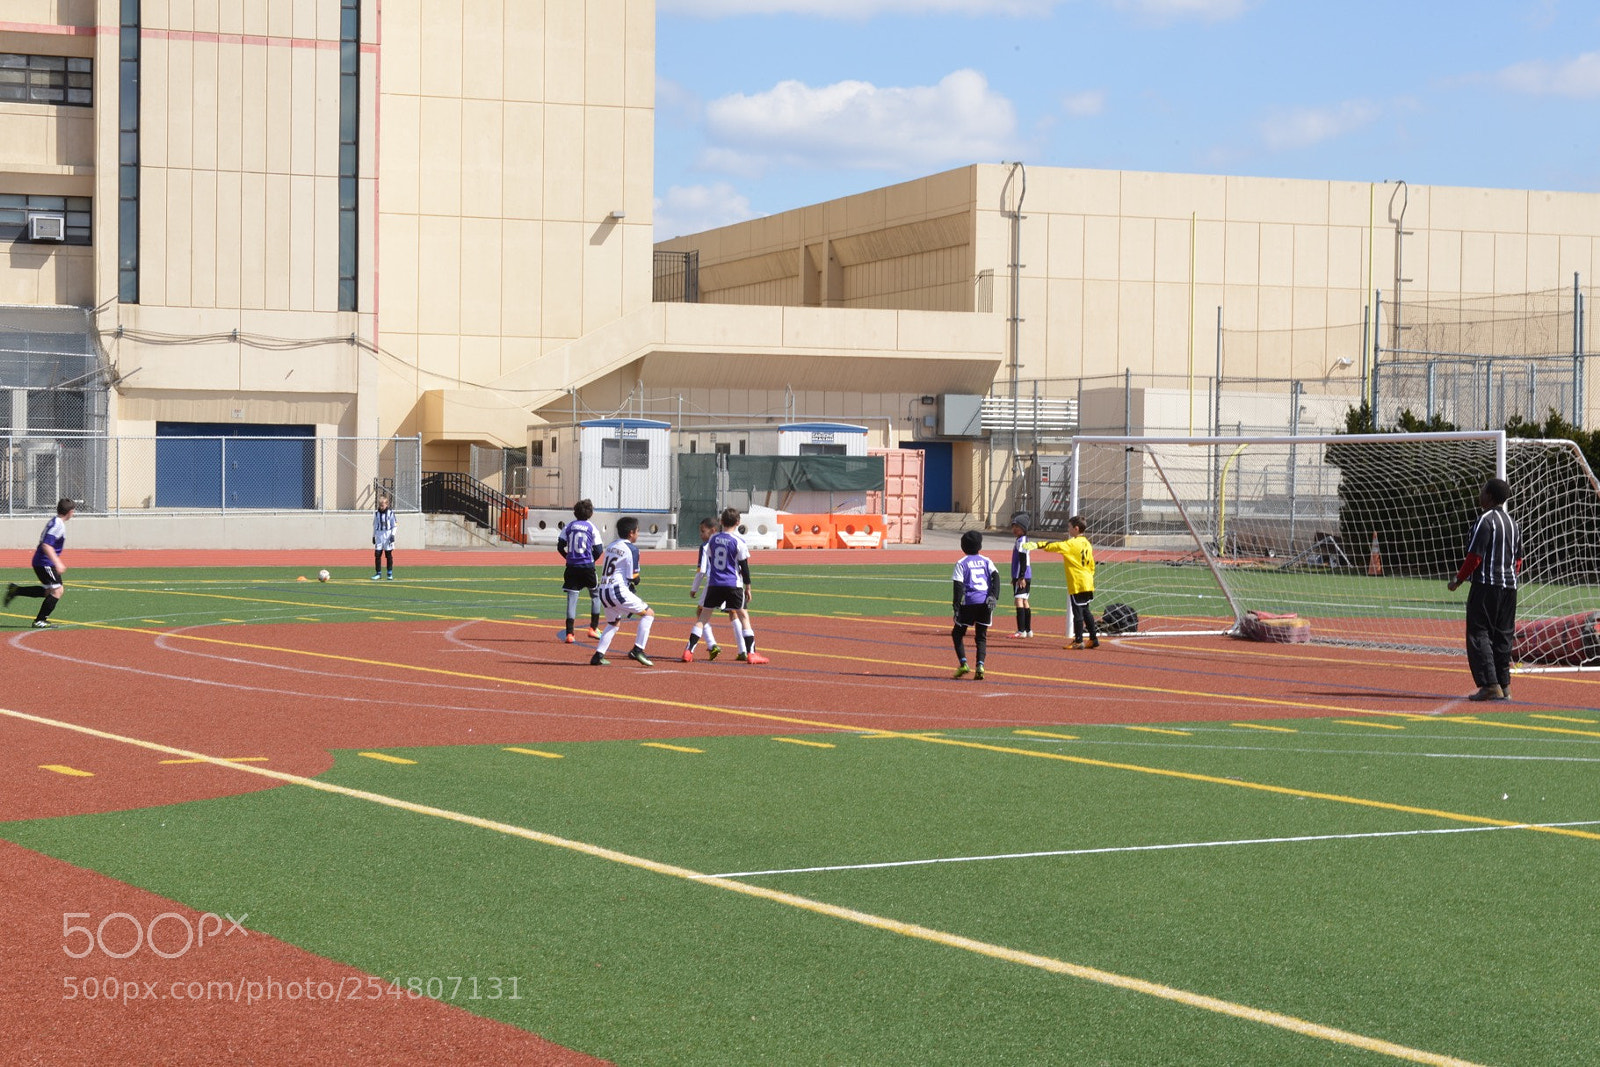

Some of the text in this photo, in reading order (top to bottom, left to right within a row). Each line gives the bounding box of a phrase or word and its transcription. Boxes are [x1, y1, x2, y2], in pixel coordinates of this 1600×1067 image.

[569, 532, 588, 553] 10
[602, 556, 618, 577] 16
[714, 546, 727, 570] 8
[970, 568, 988, 591] 5
